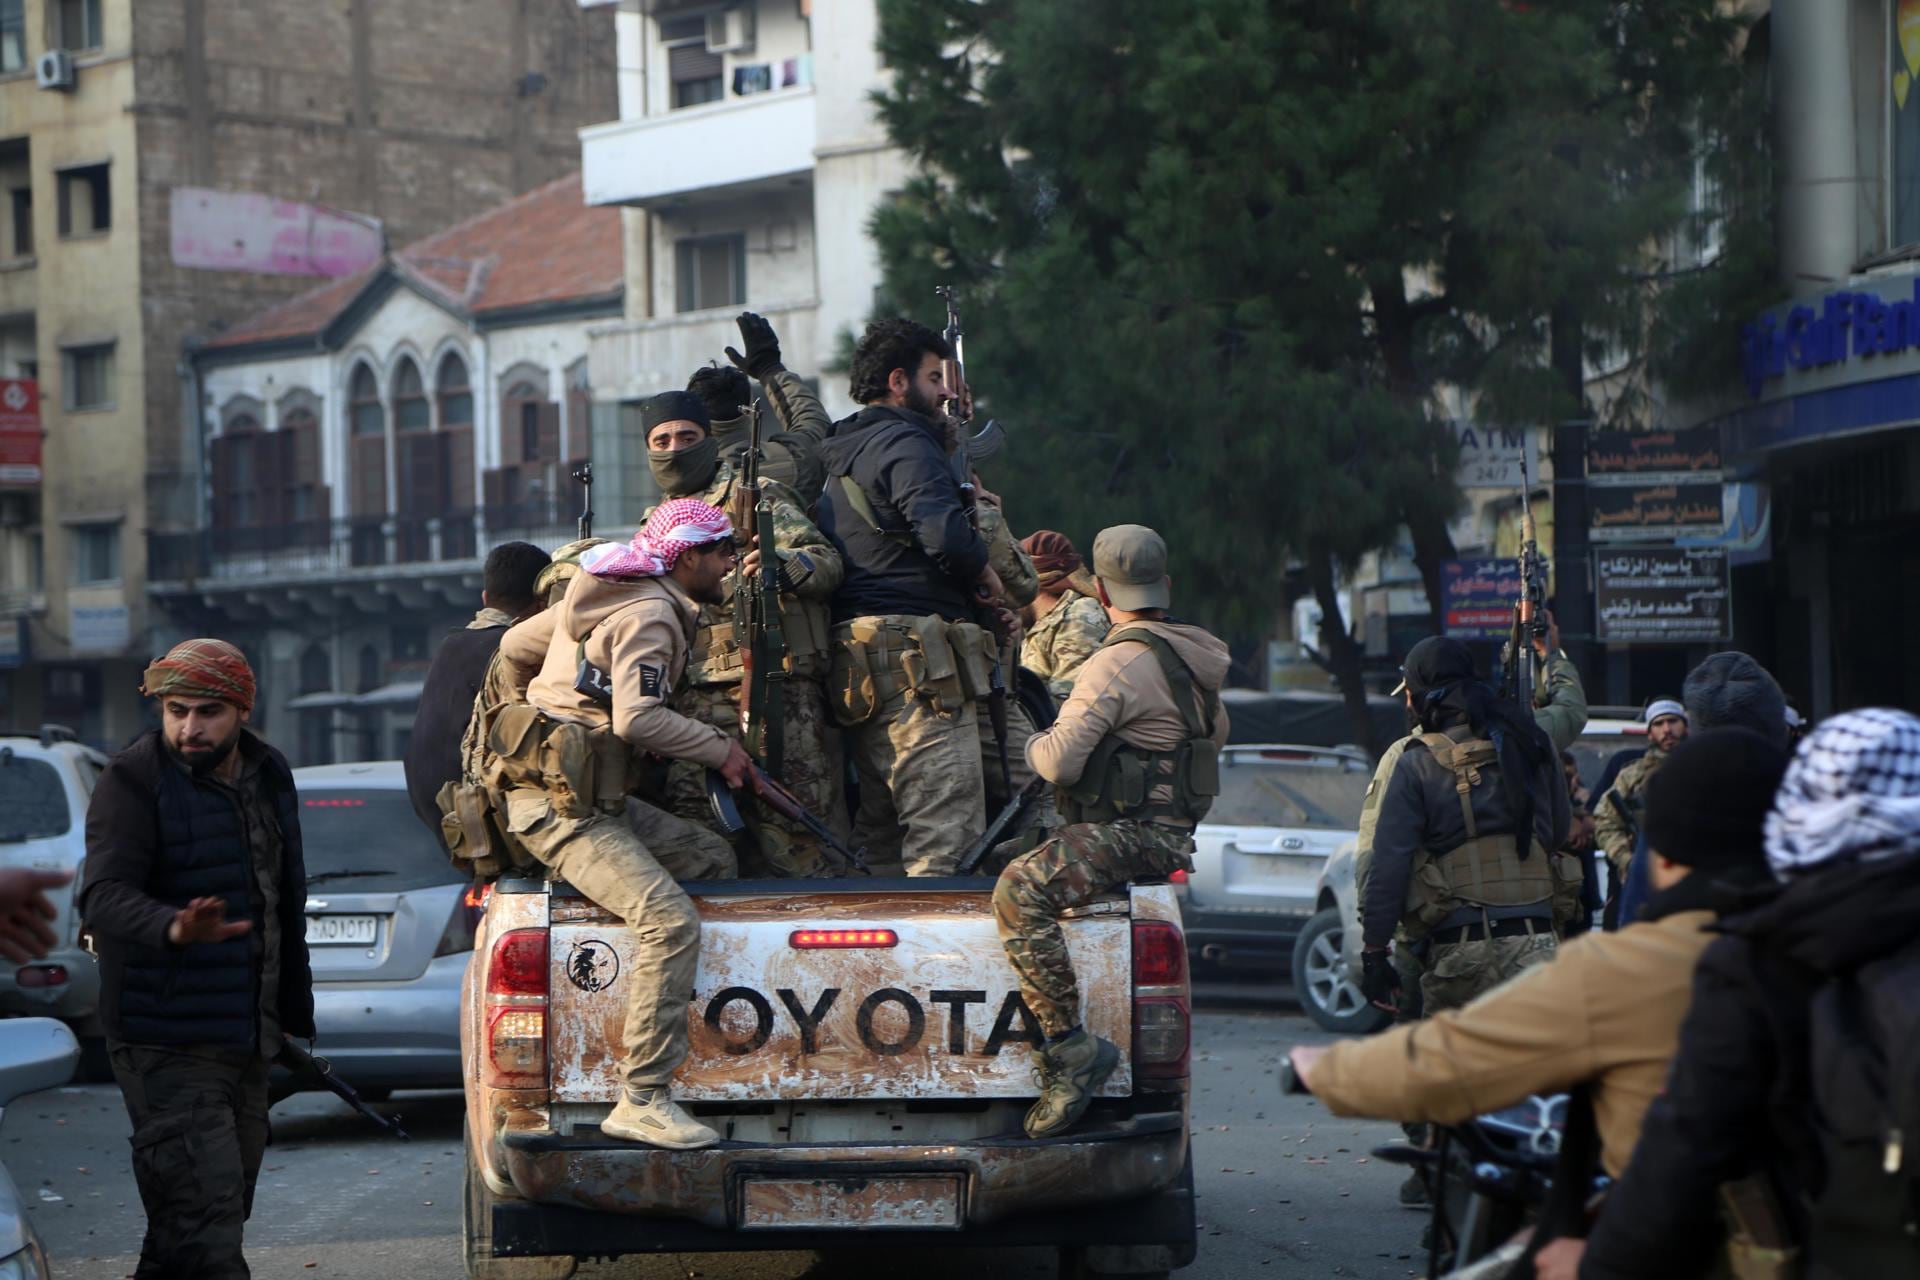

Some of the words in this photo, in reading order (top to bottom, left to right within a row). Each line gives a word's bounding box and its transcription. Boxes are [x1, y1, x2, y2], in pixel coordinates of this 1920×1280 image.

[1786, 290, 1850, 371] Gulf
[1460, 425, 1525, 448] ATM
[1476, 466, 1509, 480] 24/7
[1650, 557, 1692, 577] ياسمين
[1656, 599, 1693, 614] محمد
[691, 986, 1046, 1056] OYOTA
